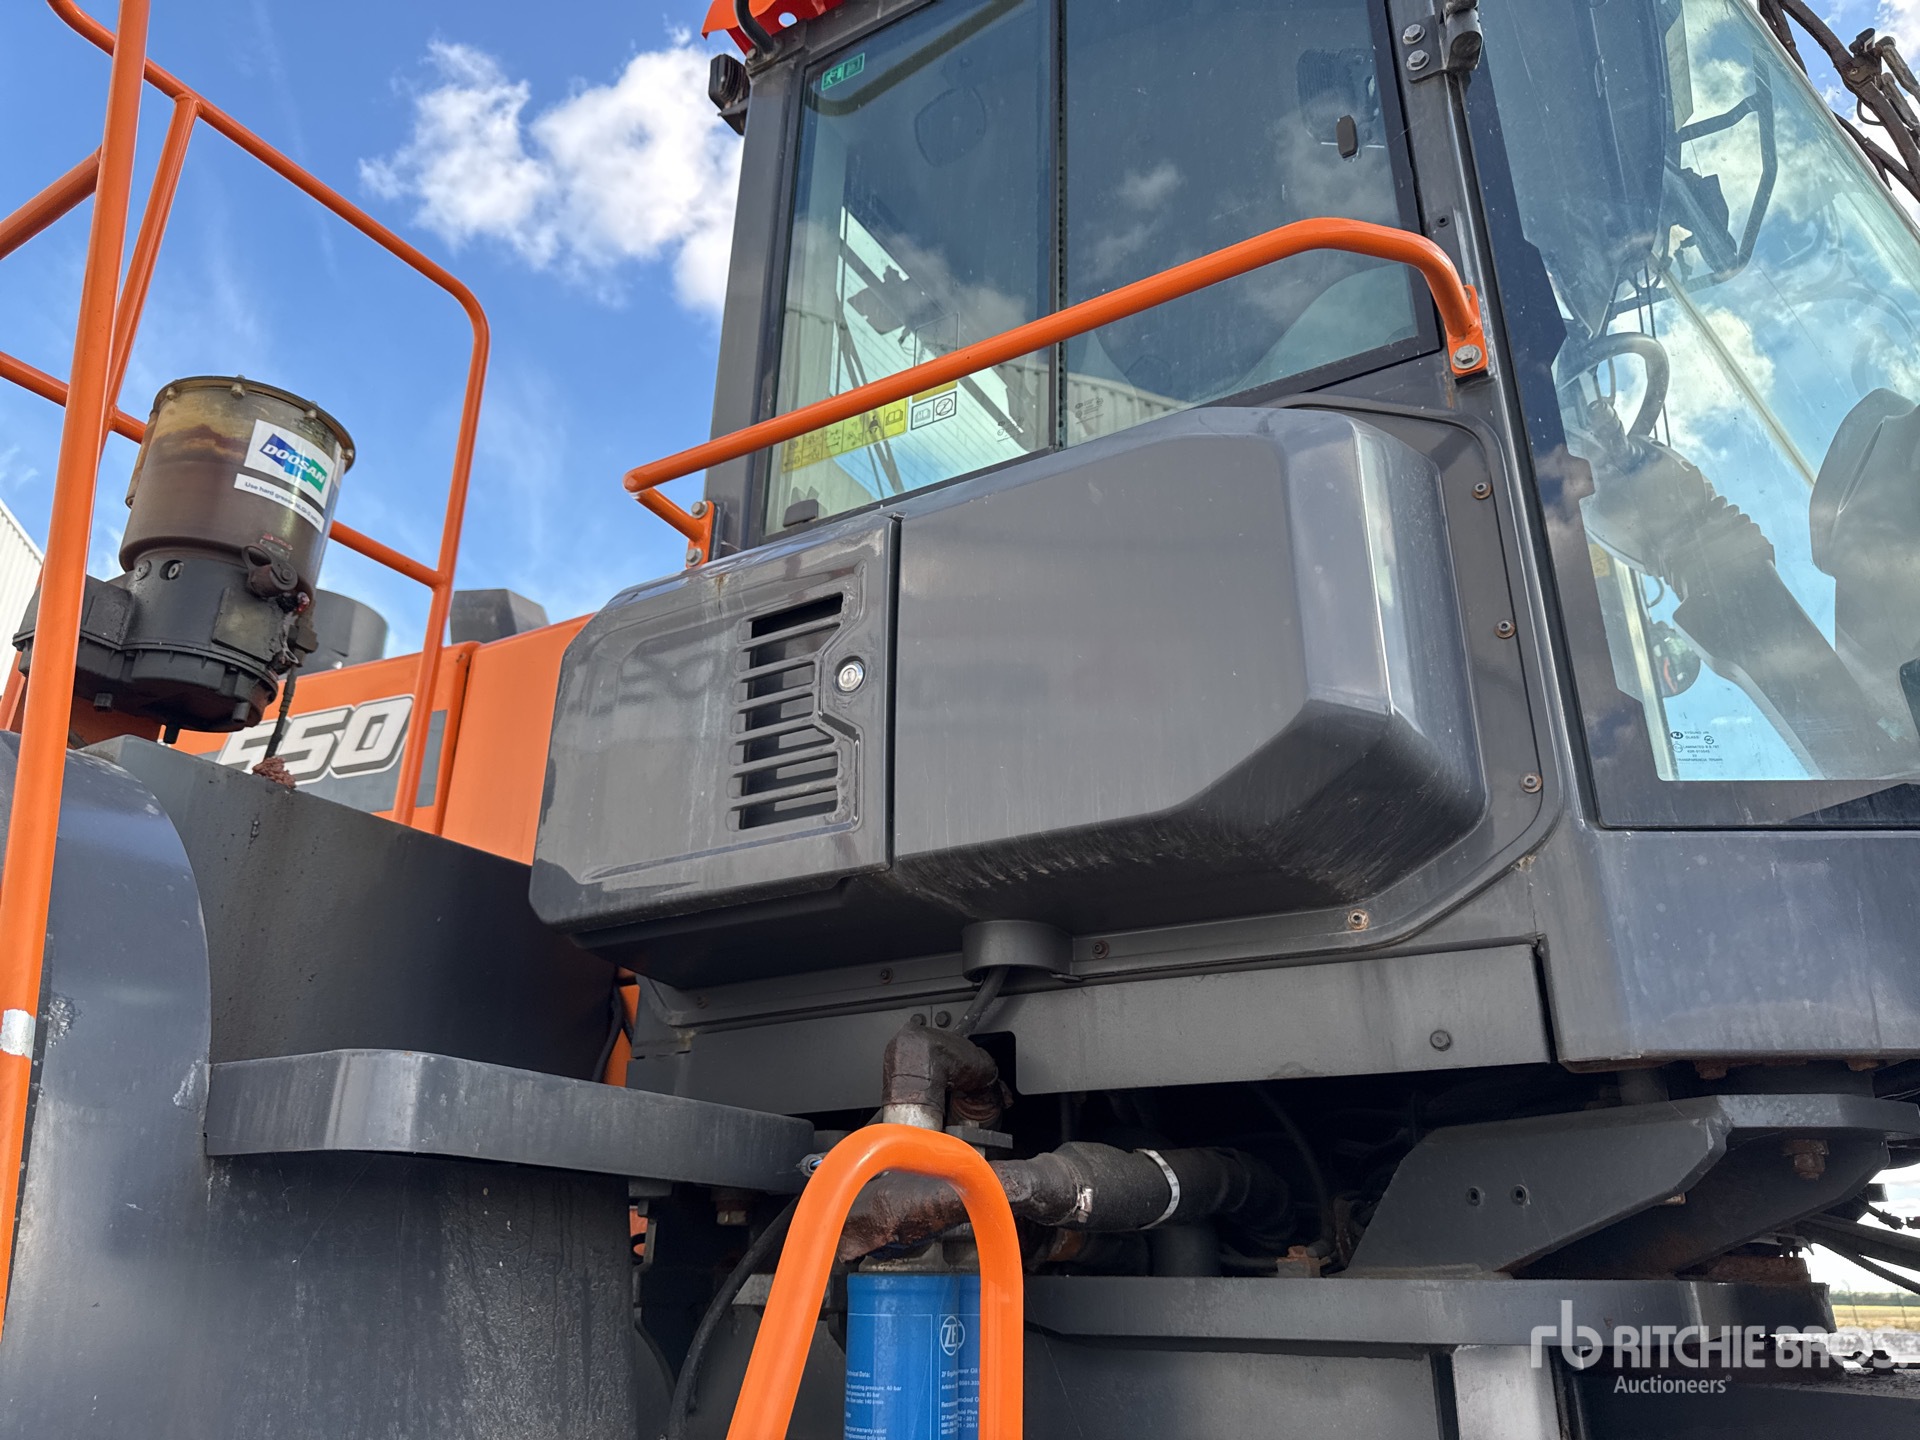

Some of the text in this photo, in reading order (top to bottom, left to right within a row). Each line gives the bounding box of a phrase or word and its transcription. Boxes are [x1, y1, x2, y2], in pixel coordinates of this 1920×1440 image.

[262, 443, 325, 484] DOOSAN
[245, 481, 258, 490] Use
[259, 486, 275, 496] hard
